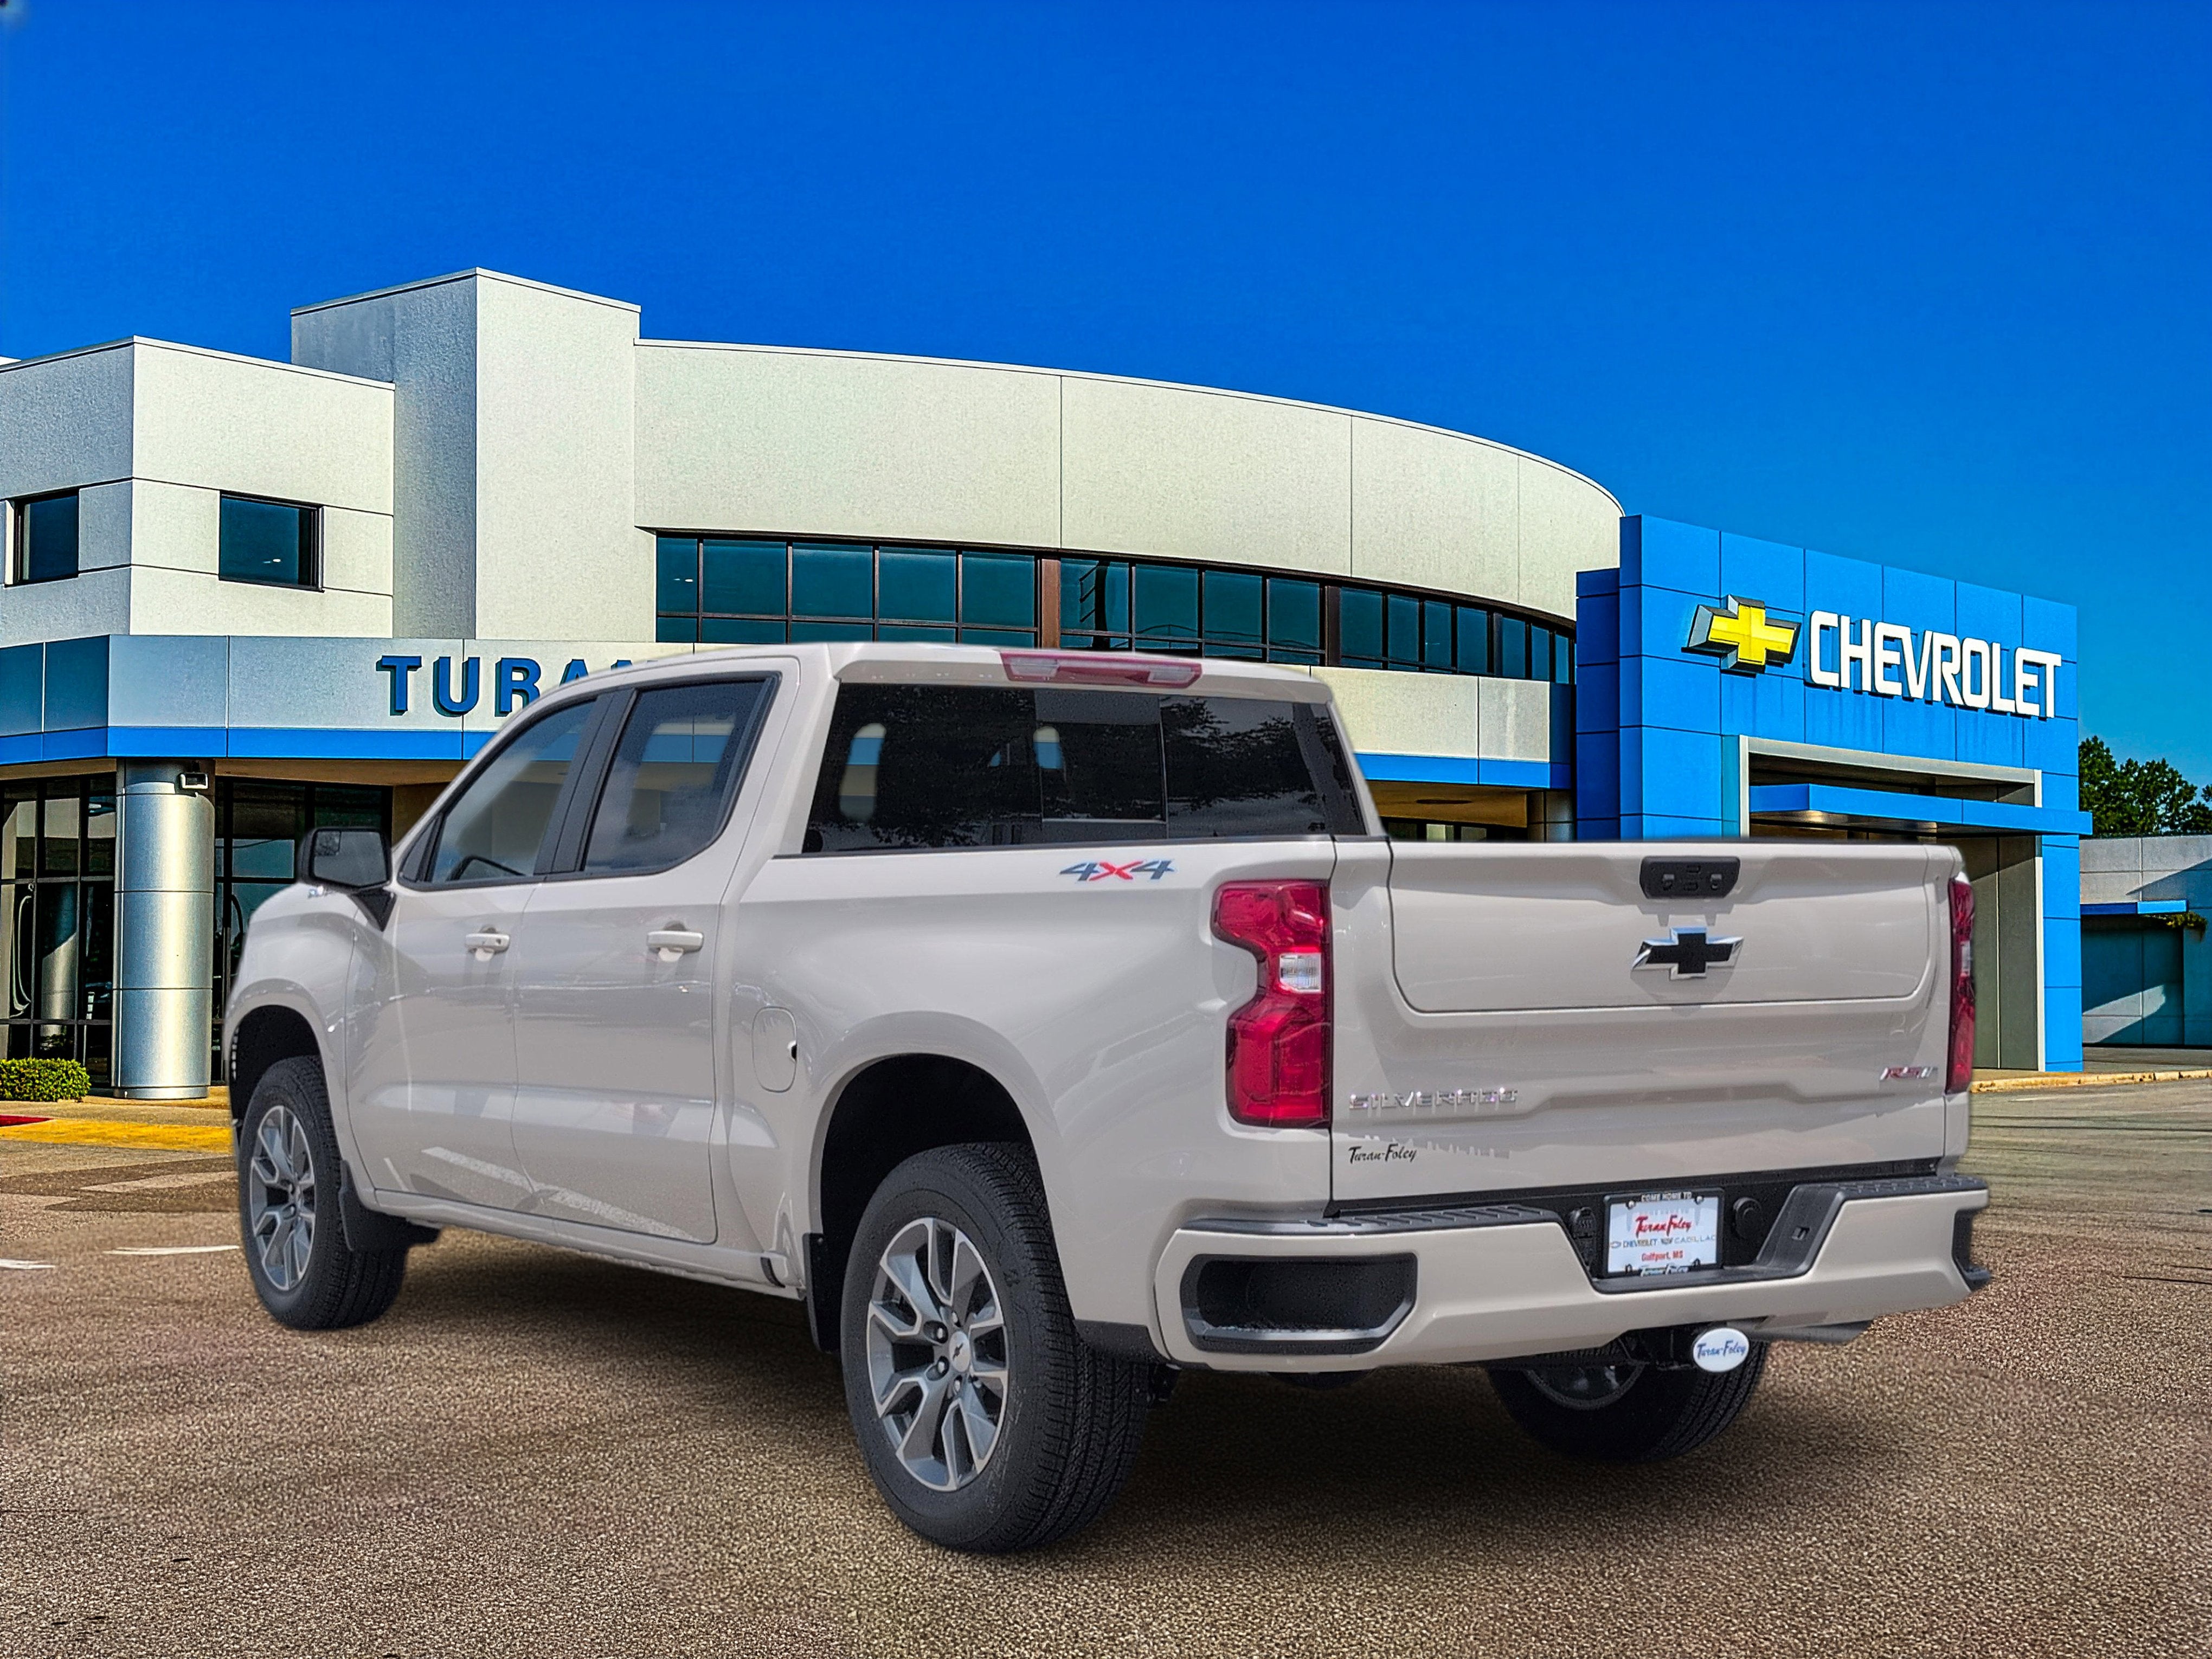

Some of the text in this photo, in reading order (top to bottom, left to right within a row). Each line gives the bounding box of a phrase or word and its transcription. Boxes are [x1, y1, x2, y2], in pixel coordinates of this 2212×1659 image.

[1809, 610, 2062, 718] CHEVROLET
[377, 655, 658, 717] TUR
[1349, 1088, 1518, 1110] SILVERADO
[1348, 1143, 1417, 1165] Turan-Foley
